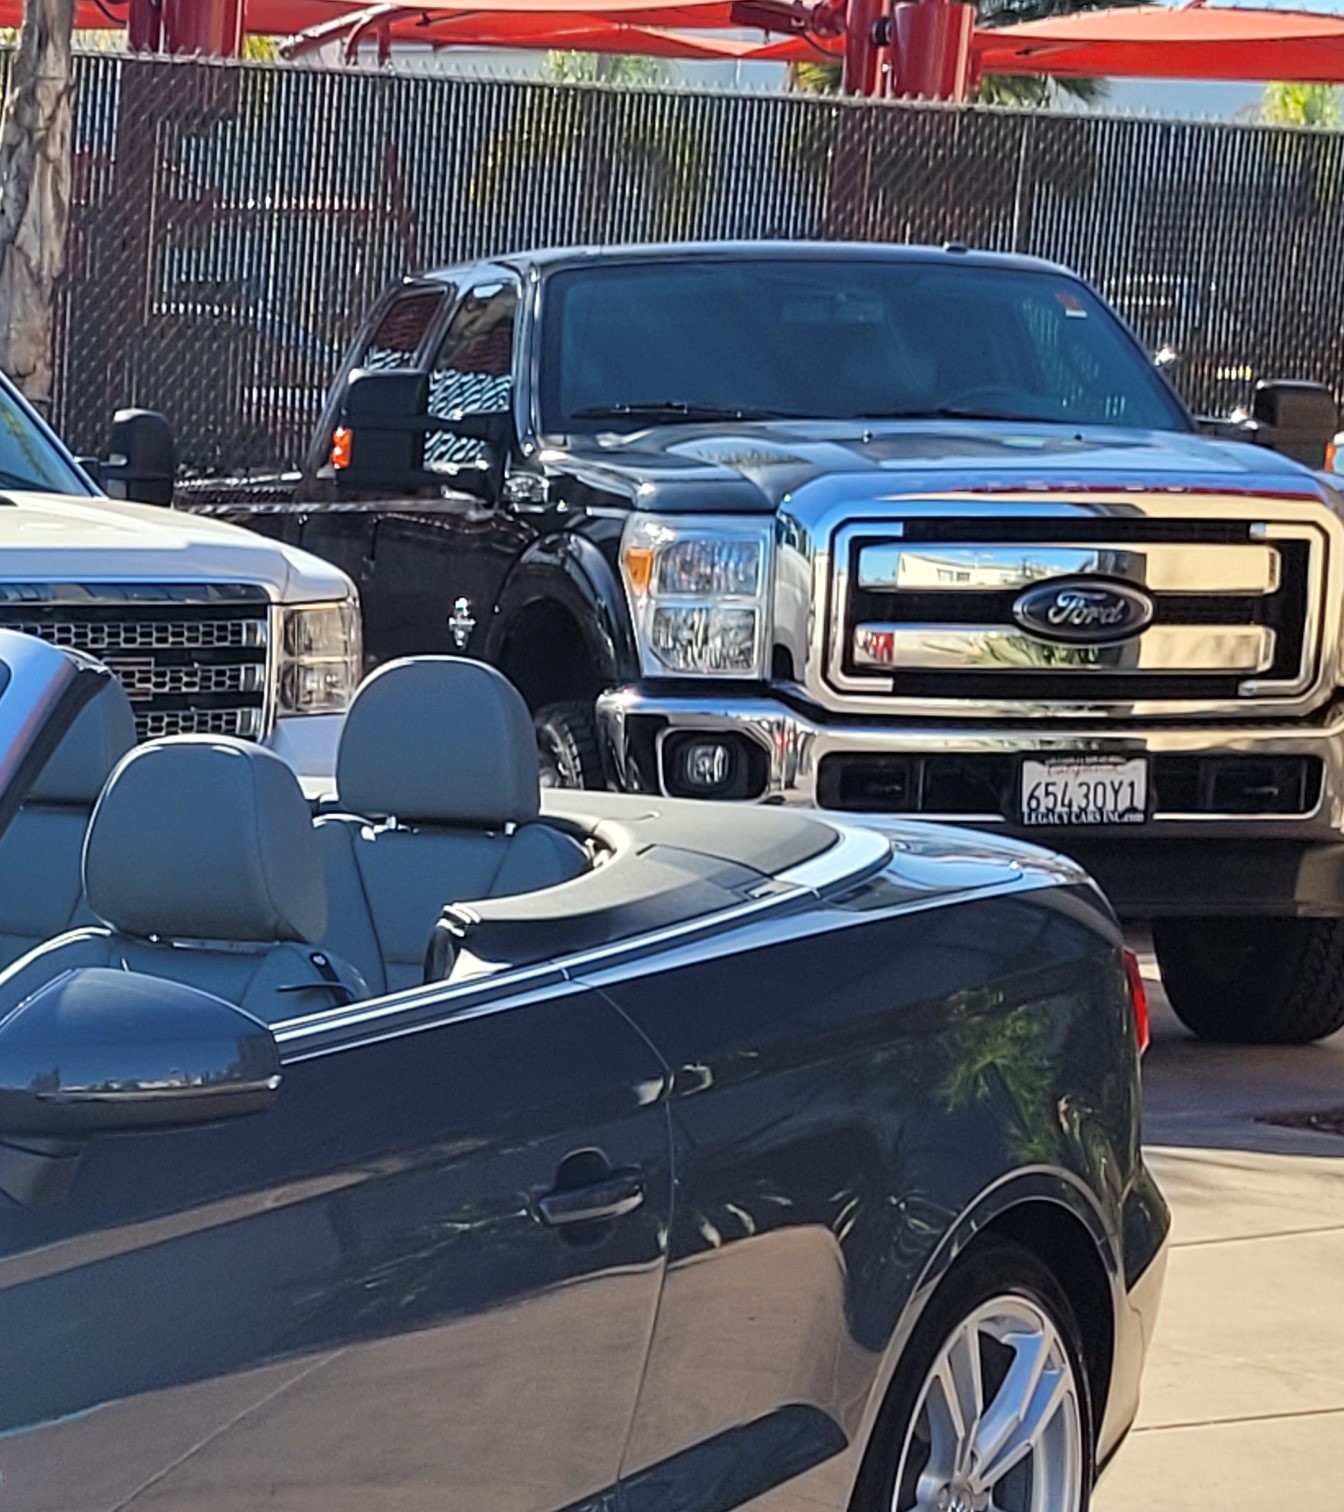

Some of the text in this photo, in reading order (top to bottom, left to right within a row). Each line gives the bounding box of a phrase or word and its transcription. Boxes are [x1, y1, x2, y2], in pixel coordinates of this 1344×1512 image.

[1048, 592, 1125, 625] Ford
[1027, 780, 1135, 812] 65430Y1
[1023, 811, 1069, 825] LEGACY
[1071, 811, 1101, 824] CARS
